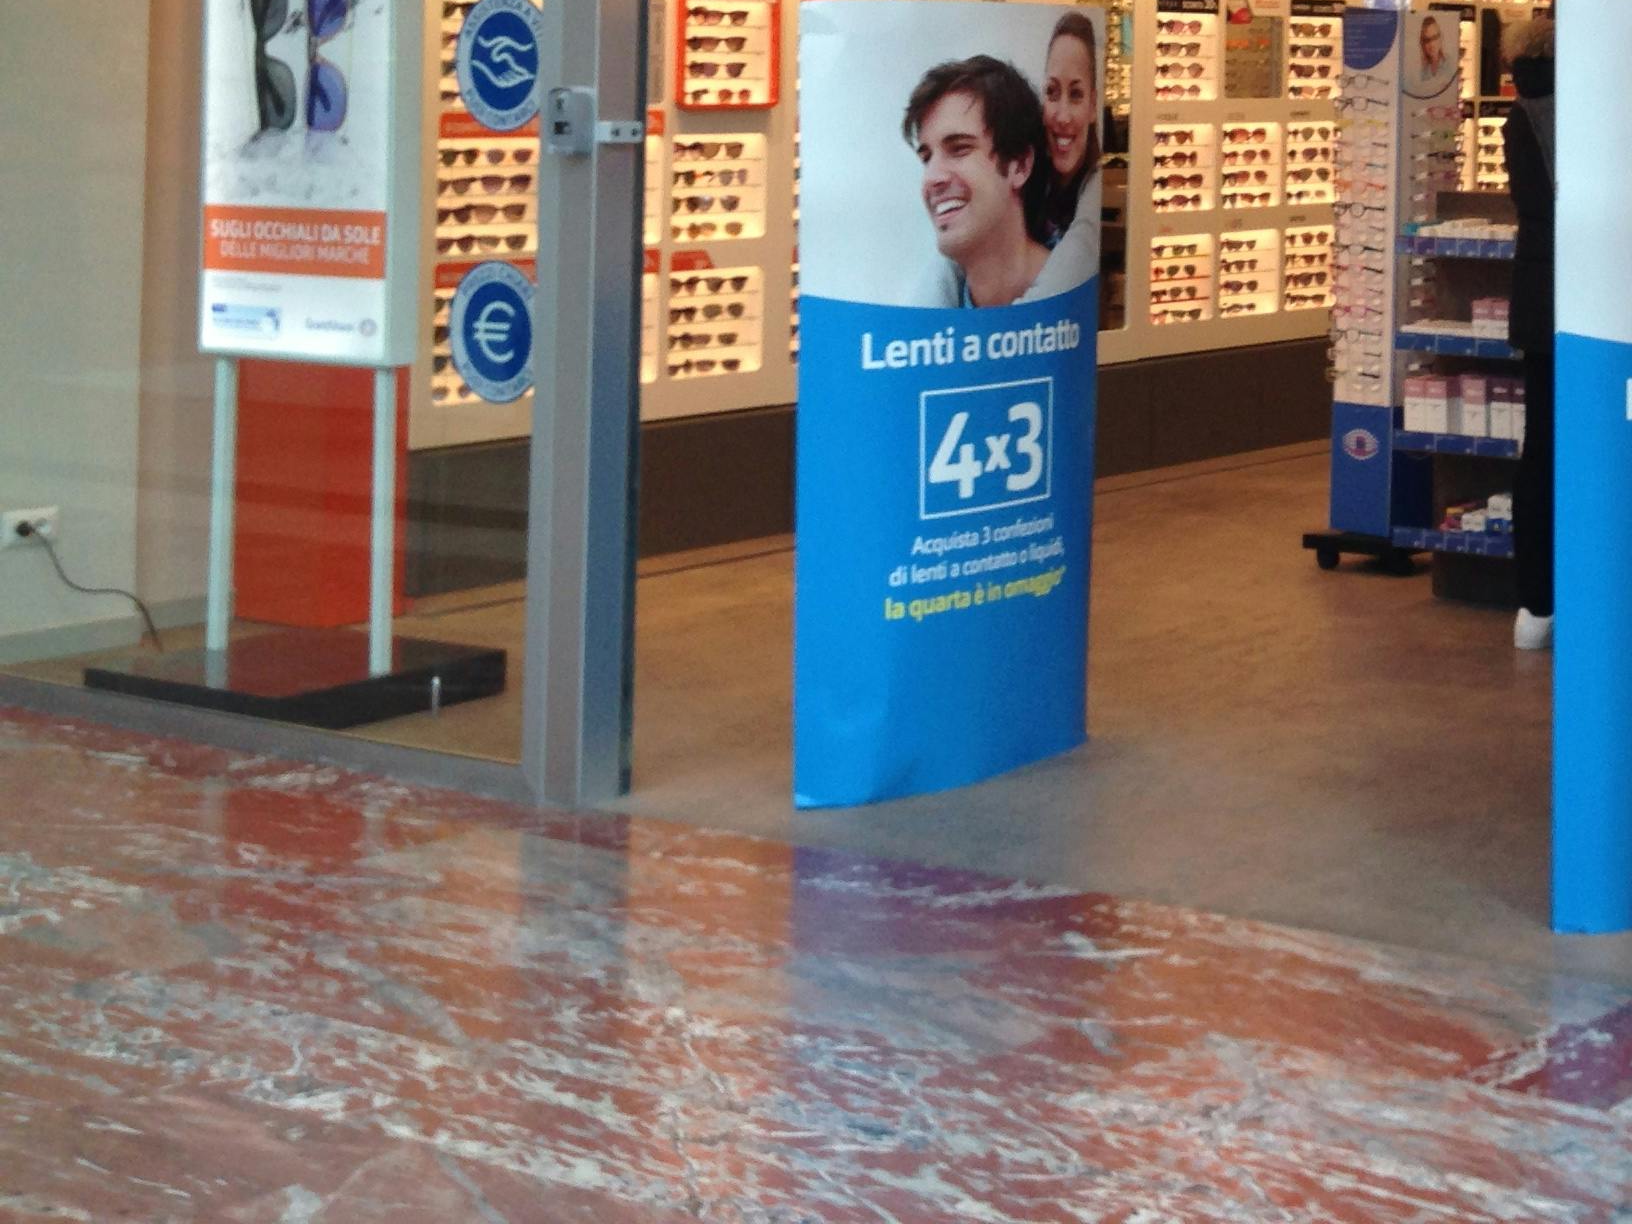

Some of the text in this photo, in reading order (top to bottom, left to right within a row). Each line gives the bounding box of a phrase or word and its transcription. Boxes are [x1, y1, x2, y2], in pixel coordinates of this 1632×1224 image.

[254, 221, 319, 241] OCCHIALI
[344, 225, 381, 245] SOLE
[861, 320, 1080, 370] Lenti a contatto
[928, 401, 1044, 498] 4x3
[911, 531, 980, 557] Acquista
[982, 526, 991, 545] 3
[888, 565, 908, 586] di
[911, 560, 948, 584] lenti
[951, 562, 960, 577] a
[962, 551, 1018, 576] contatto
[1020, 550, 1028, 563] o
[885, 597, 906, 620] la
[908, 591, 972, 621] quarta
[974, 582, 985, 605] è
[987, 579, 1001, 601] in
